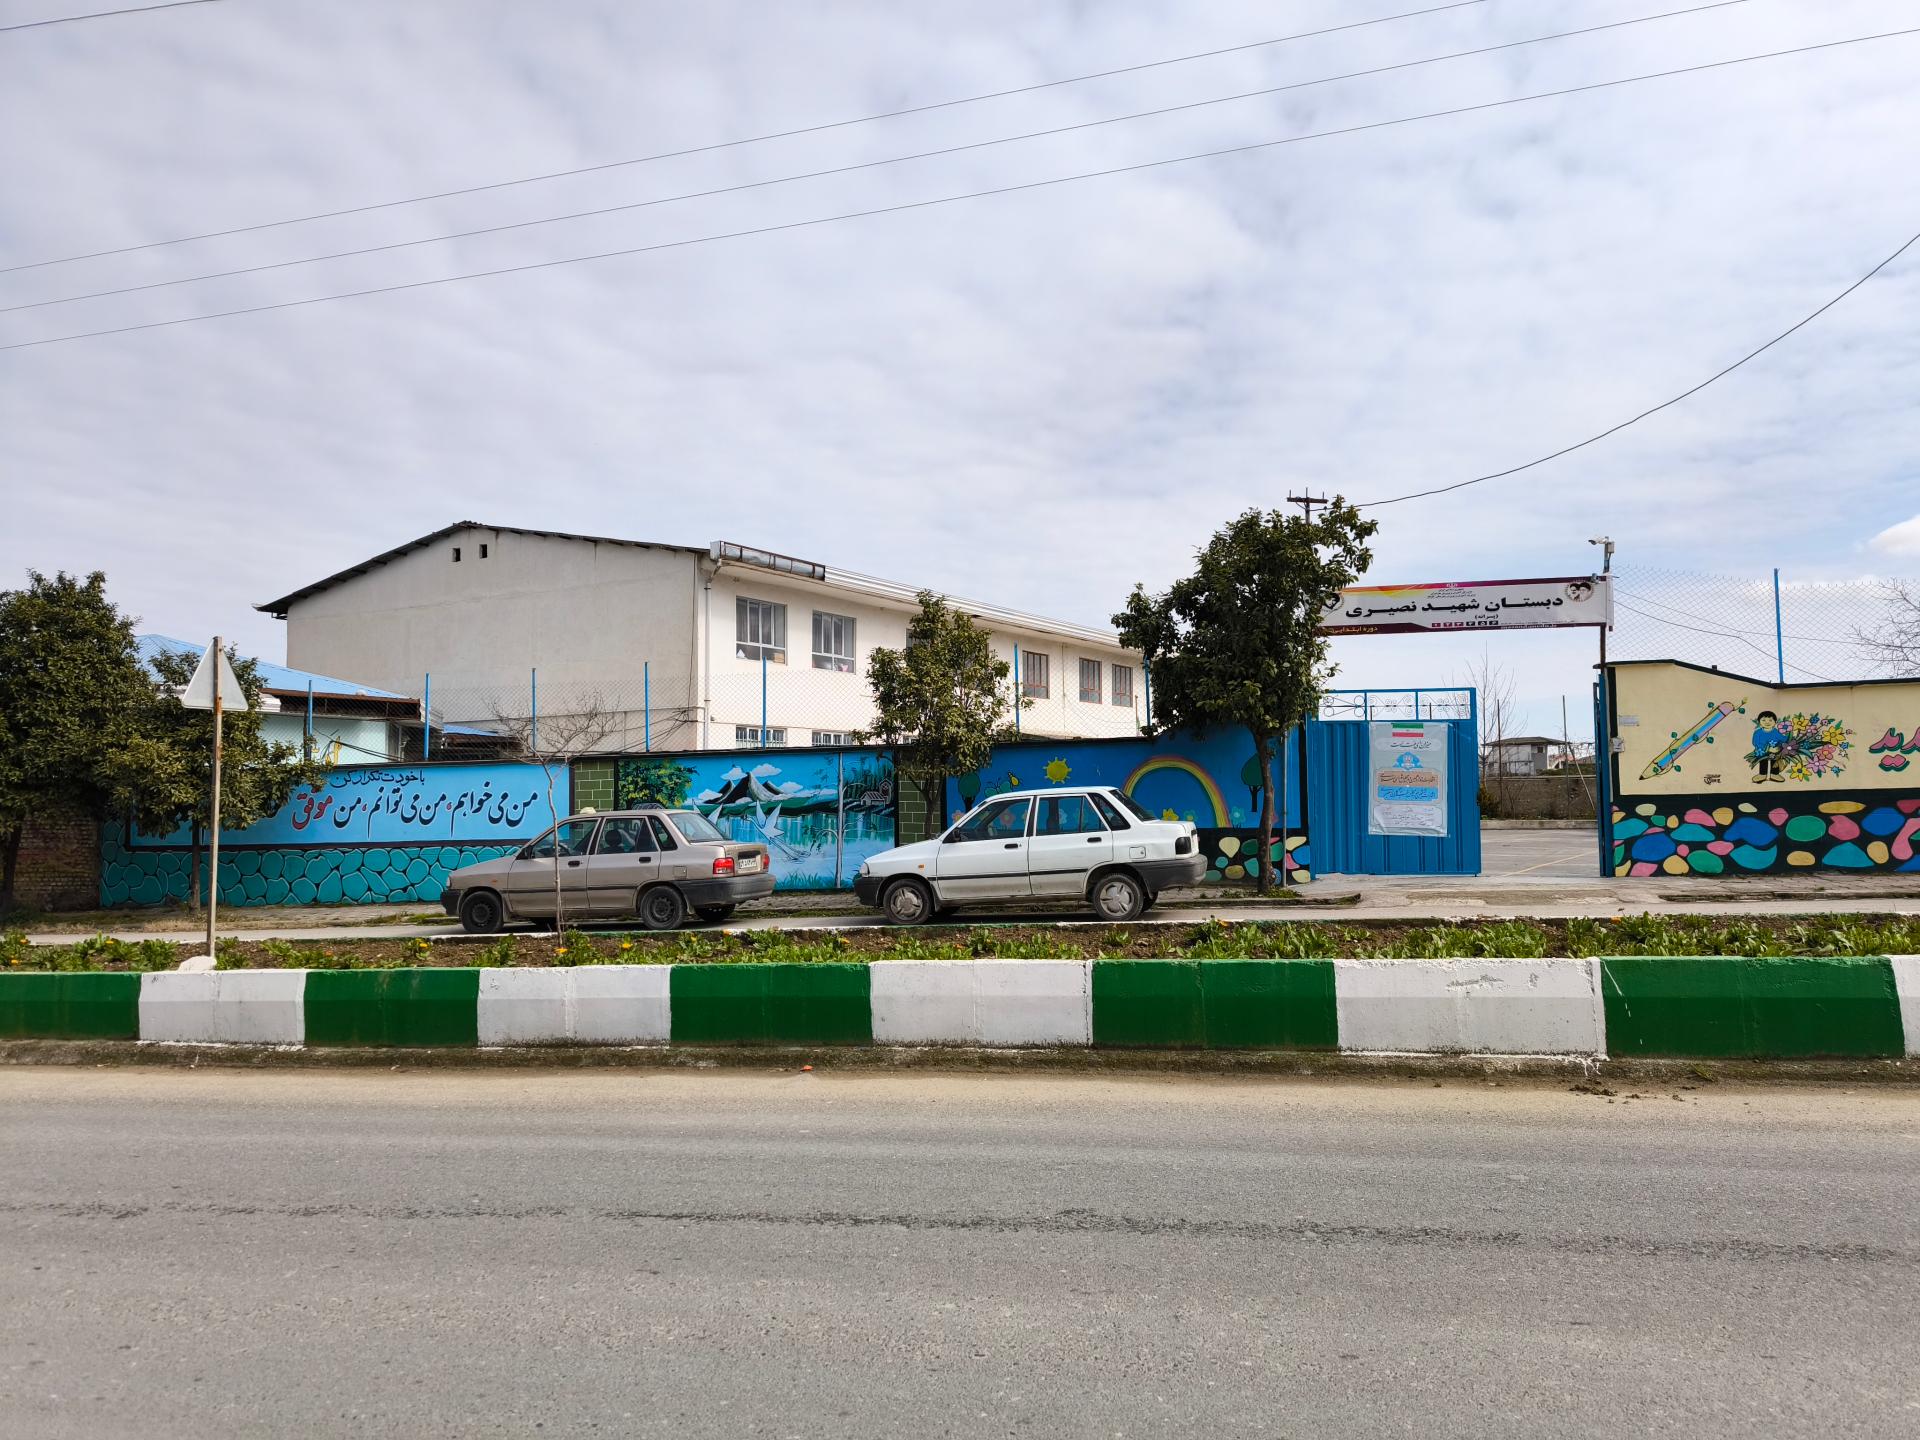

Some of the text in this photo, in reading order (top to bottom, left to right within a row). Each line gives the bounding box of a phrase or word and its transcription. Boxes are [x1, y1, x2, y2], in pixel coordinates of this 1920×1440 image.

[1345, 596, 1564, 618] دبستان شهید نصیری
[330, 770, 353, 788] کن
[292, 787, 333, 831] موفق
[333, 797, 362, 828] من
[419, 793, 447, 826] من
[505, 792, 538, 828] من
